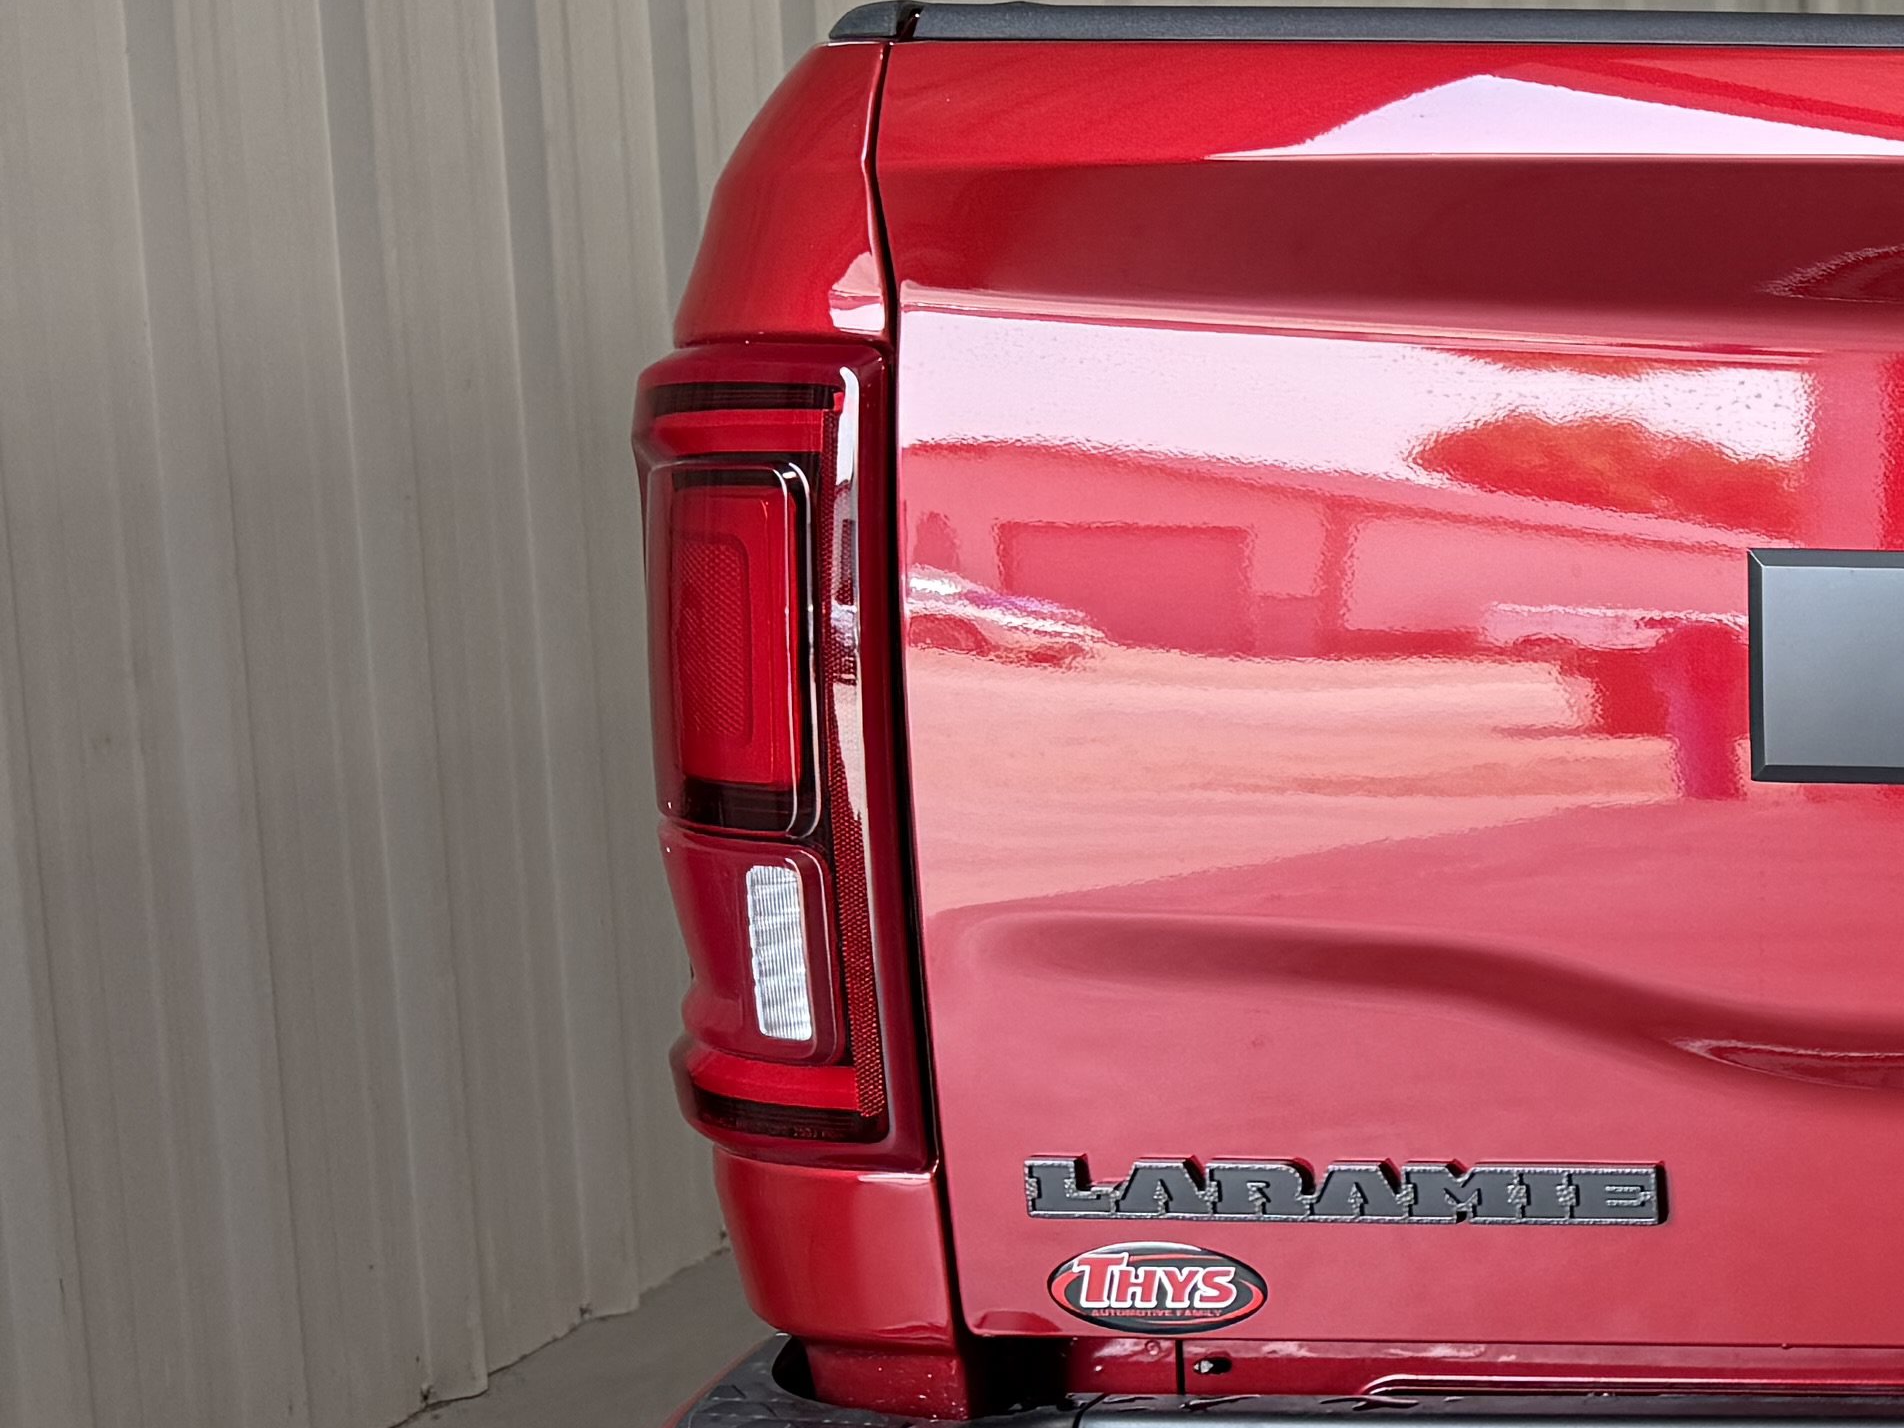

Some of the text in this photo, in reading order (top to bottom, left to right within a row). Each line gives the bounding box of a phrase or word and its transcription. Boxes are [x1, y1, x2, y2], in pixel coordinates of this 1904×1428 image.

[1024, 1157, 1665, 1226] LARAMIE
[1072, 1251, 1238, 1309] THYS
[1091, 1308, 1223, 1318] AUTOMOTIVE FAMILY
